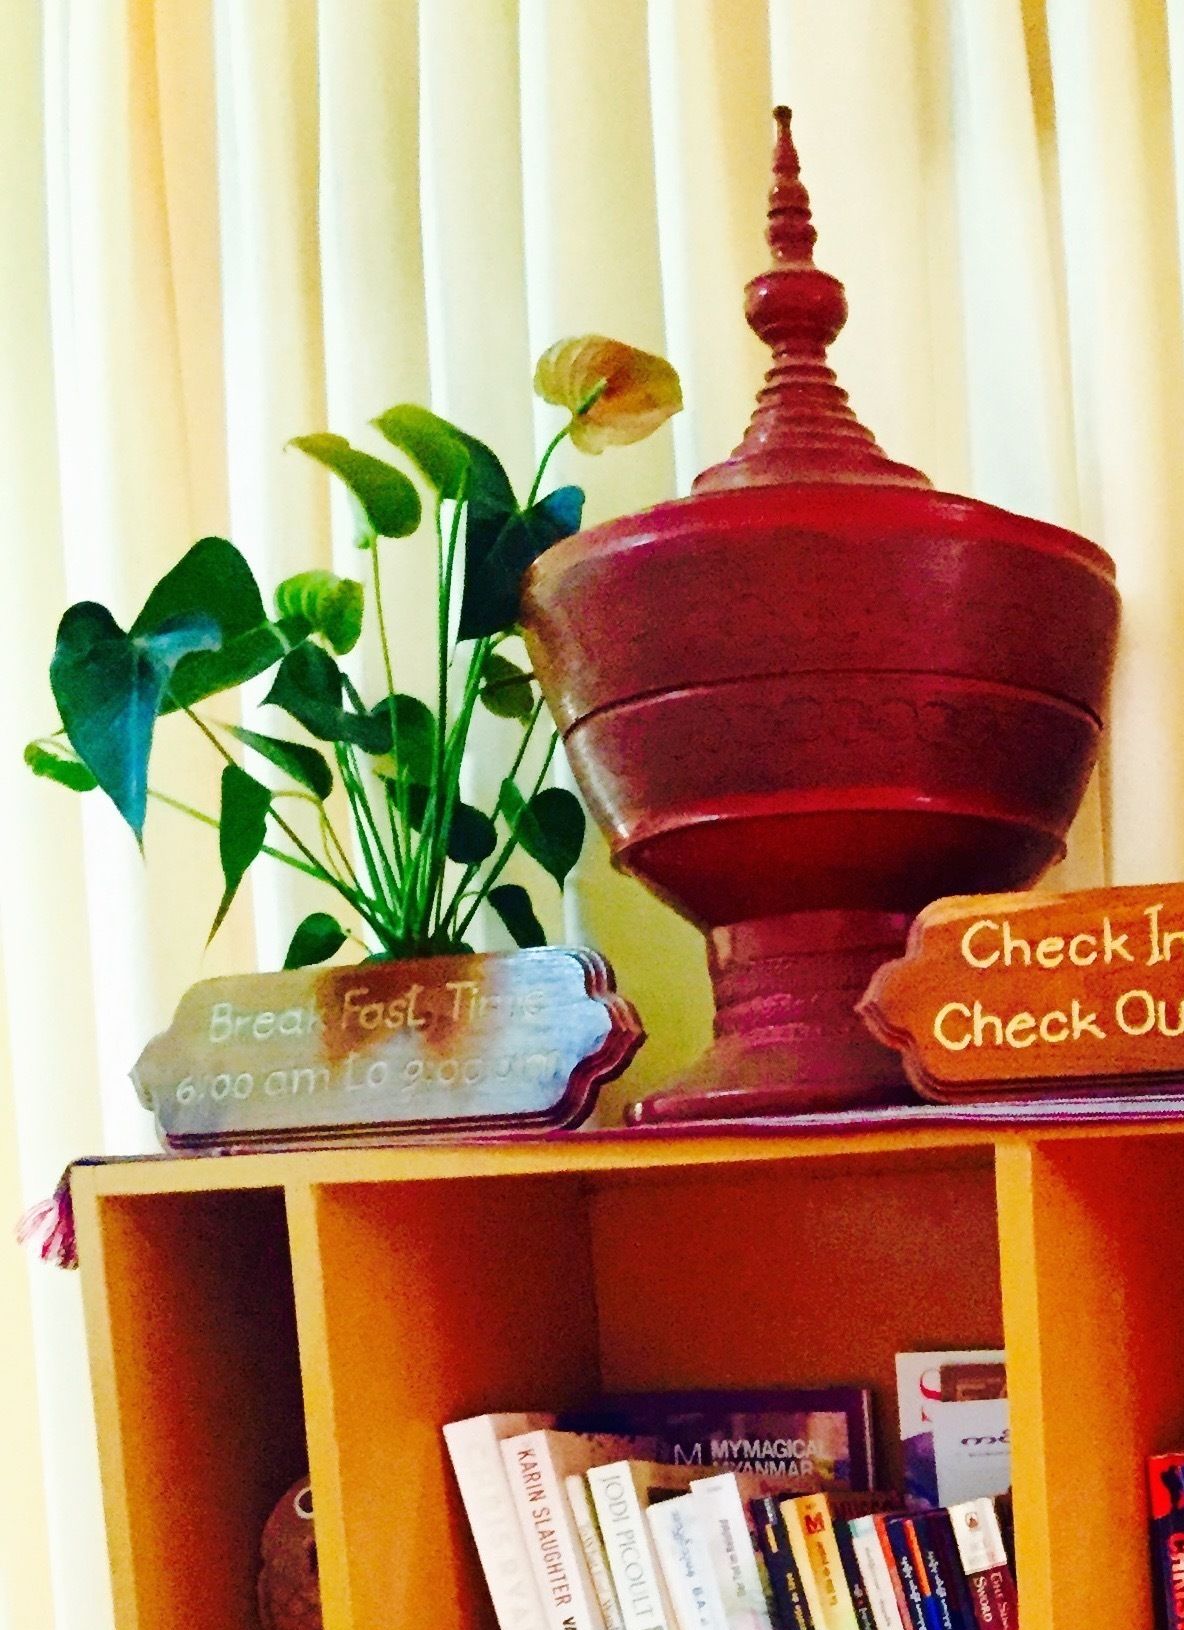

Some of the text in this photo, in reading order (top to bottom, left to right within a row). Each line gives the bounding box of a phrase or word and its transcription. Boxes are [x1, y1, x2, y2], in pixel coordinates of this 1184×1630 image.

[961, 916, 1135, 970] Check
[342, 986, 425, 1031] Fast
[933, 999, 1107, 1051] Check
[264, 1066, 331, 1097] am
[512, 1446, 549, 1504] KARIN
[525, 1505, 579, 1607] SLAUGHTER
[599, 1473, 656, 1619] JODI PICOULT
[972, 1575, 994, 1623] SWORD
